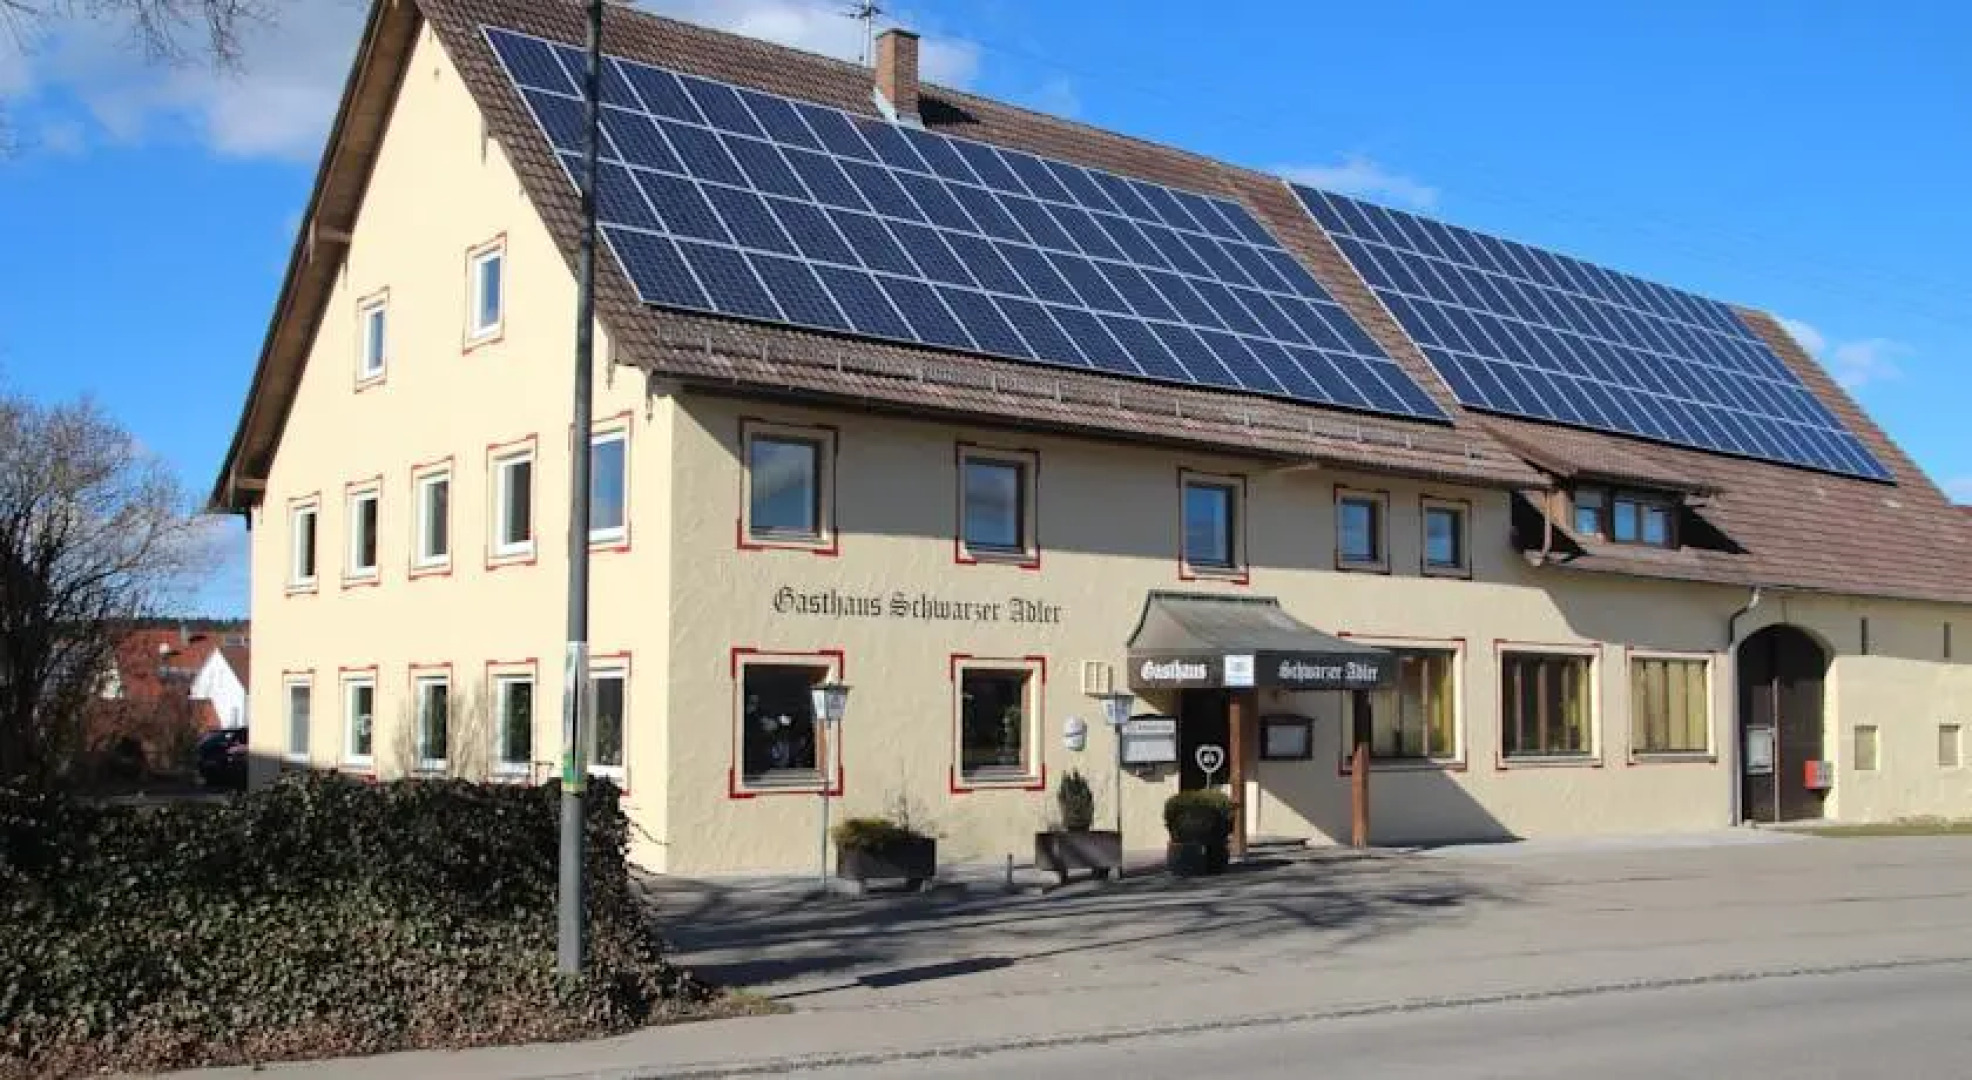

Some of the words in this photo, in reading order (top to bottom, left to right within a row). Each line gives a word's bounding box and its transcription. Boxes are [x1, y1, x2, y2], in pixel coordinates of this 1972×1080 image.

[773, 586, 882, 619] Gasthaus
[889, 591, 1000, 624] Schwarzer
[1008, 597, 1063, 624] Adler
[1140, 659, 1208, 683] Gasthaus
